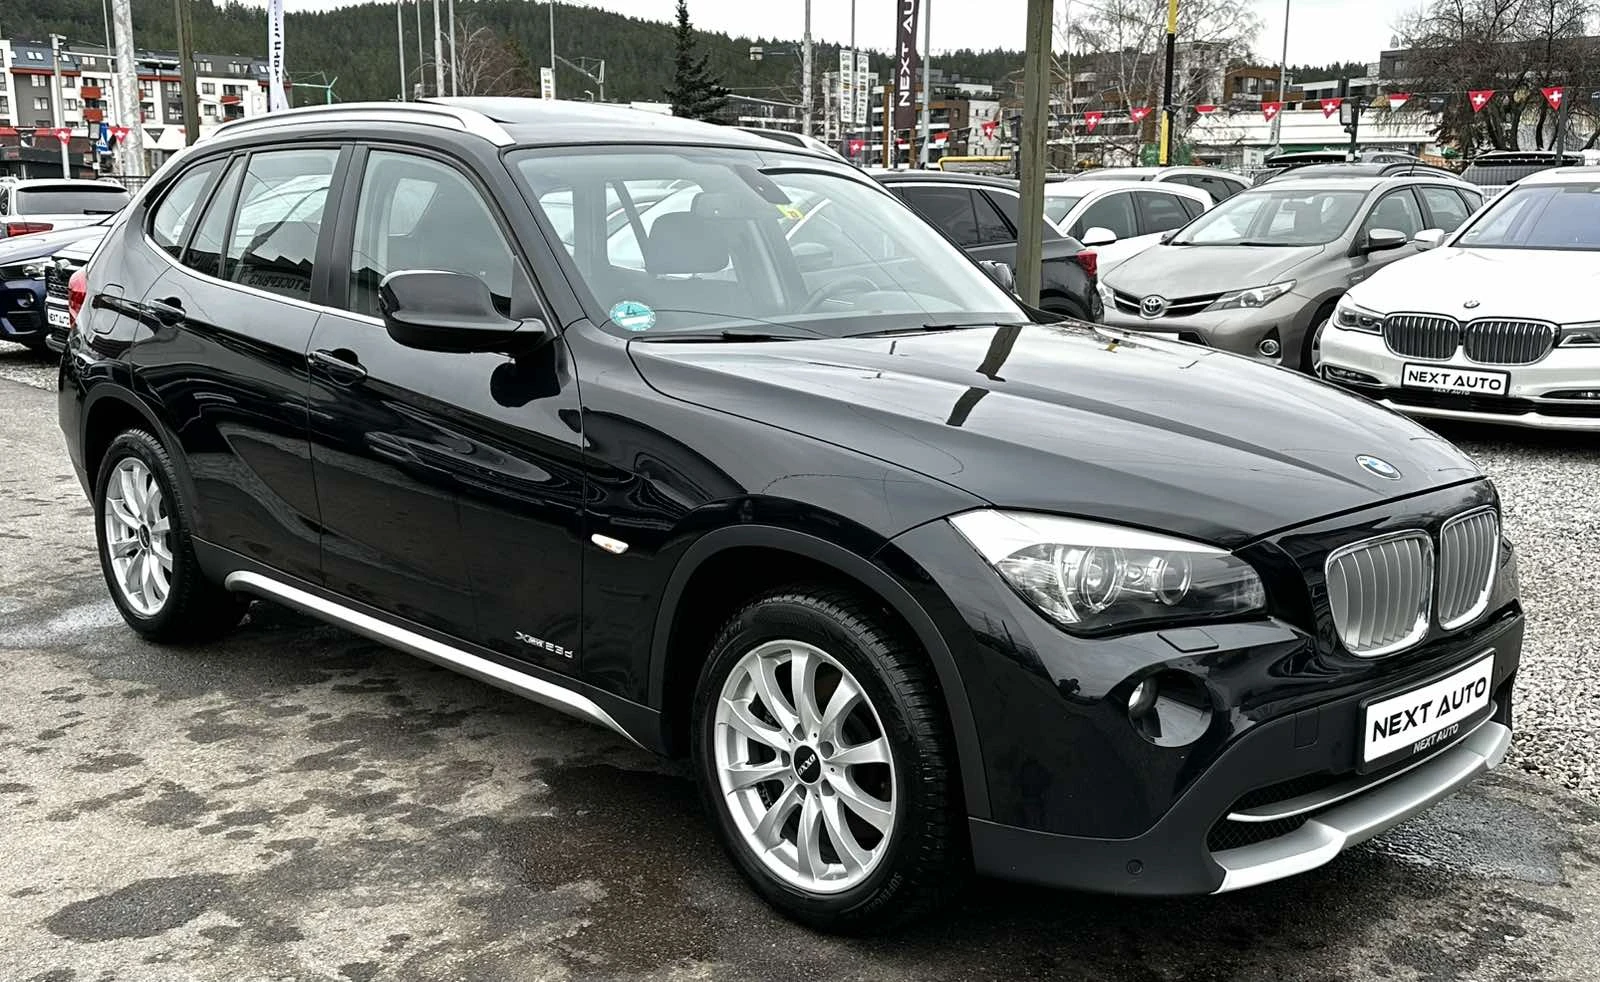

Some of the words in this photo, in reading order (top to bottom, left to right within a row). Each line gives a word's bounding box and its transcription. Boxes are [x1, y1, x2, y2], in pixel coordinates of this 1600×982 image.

[899, 41, 911, 107] NEXT
[1408, 370, 1451, 385] NEXT
[1453, 375, 1502, 391] AUTO
[1372, 700, 1433, 742] NEXT
[1435, 676, 1487, 718] AUTO
[1413, 733, 1438, 754] NEXT
[1436, 723, 1459, 742] AUTO
